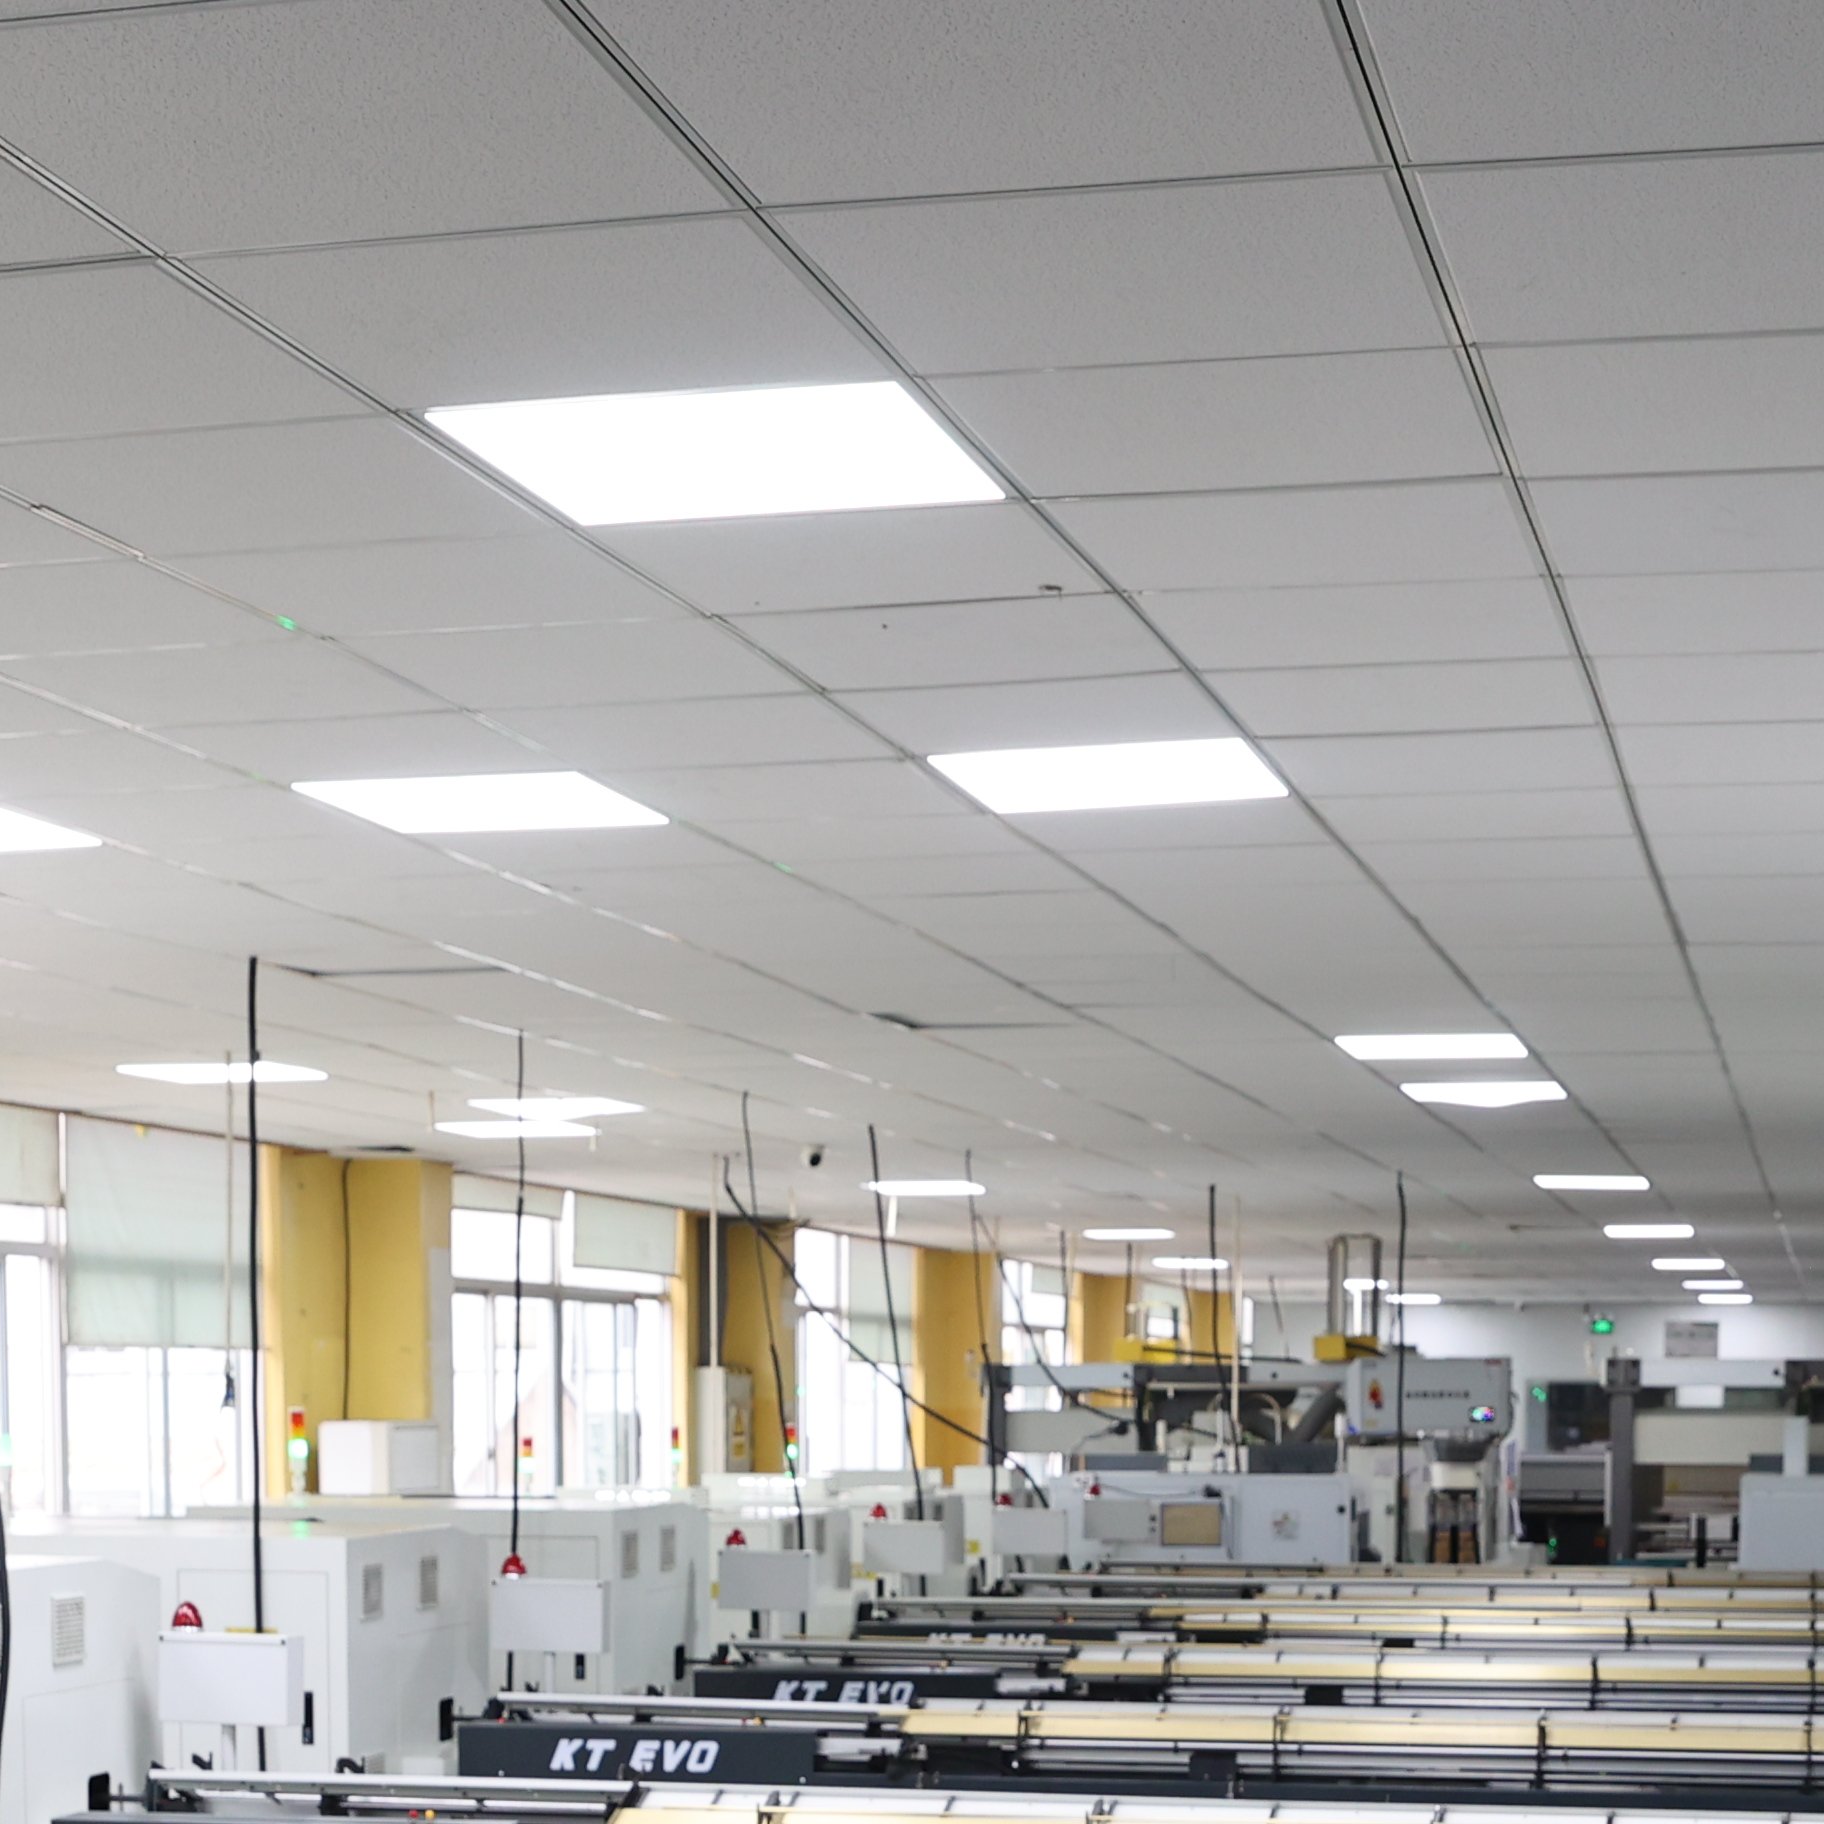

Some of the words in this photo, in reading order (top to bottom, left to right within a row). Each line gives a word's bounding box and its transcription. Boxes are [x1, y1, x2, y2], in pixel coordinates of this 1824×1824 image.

[773, 1680, 828, 1701] KT
[838, 1681, 914, 1704] EVO
[549, 1738, 617, 1771] KT
[629, 1740, 719, 1773] EVO
